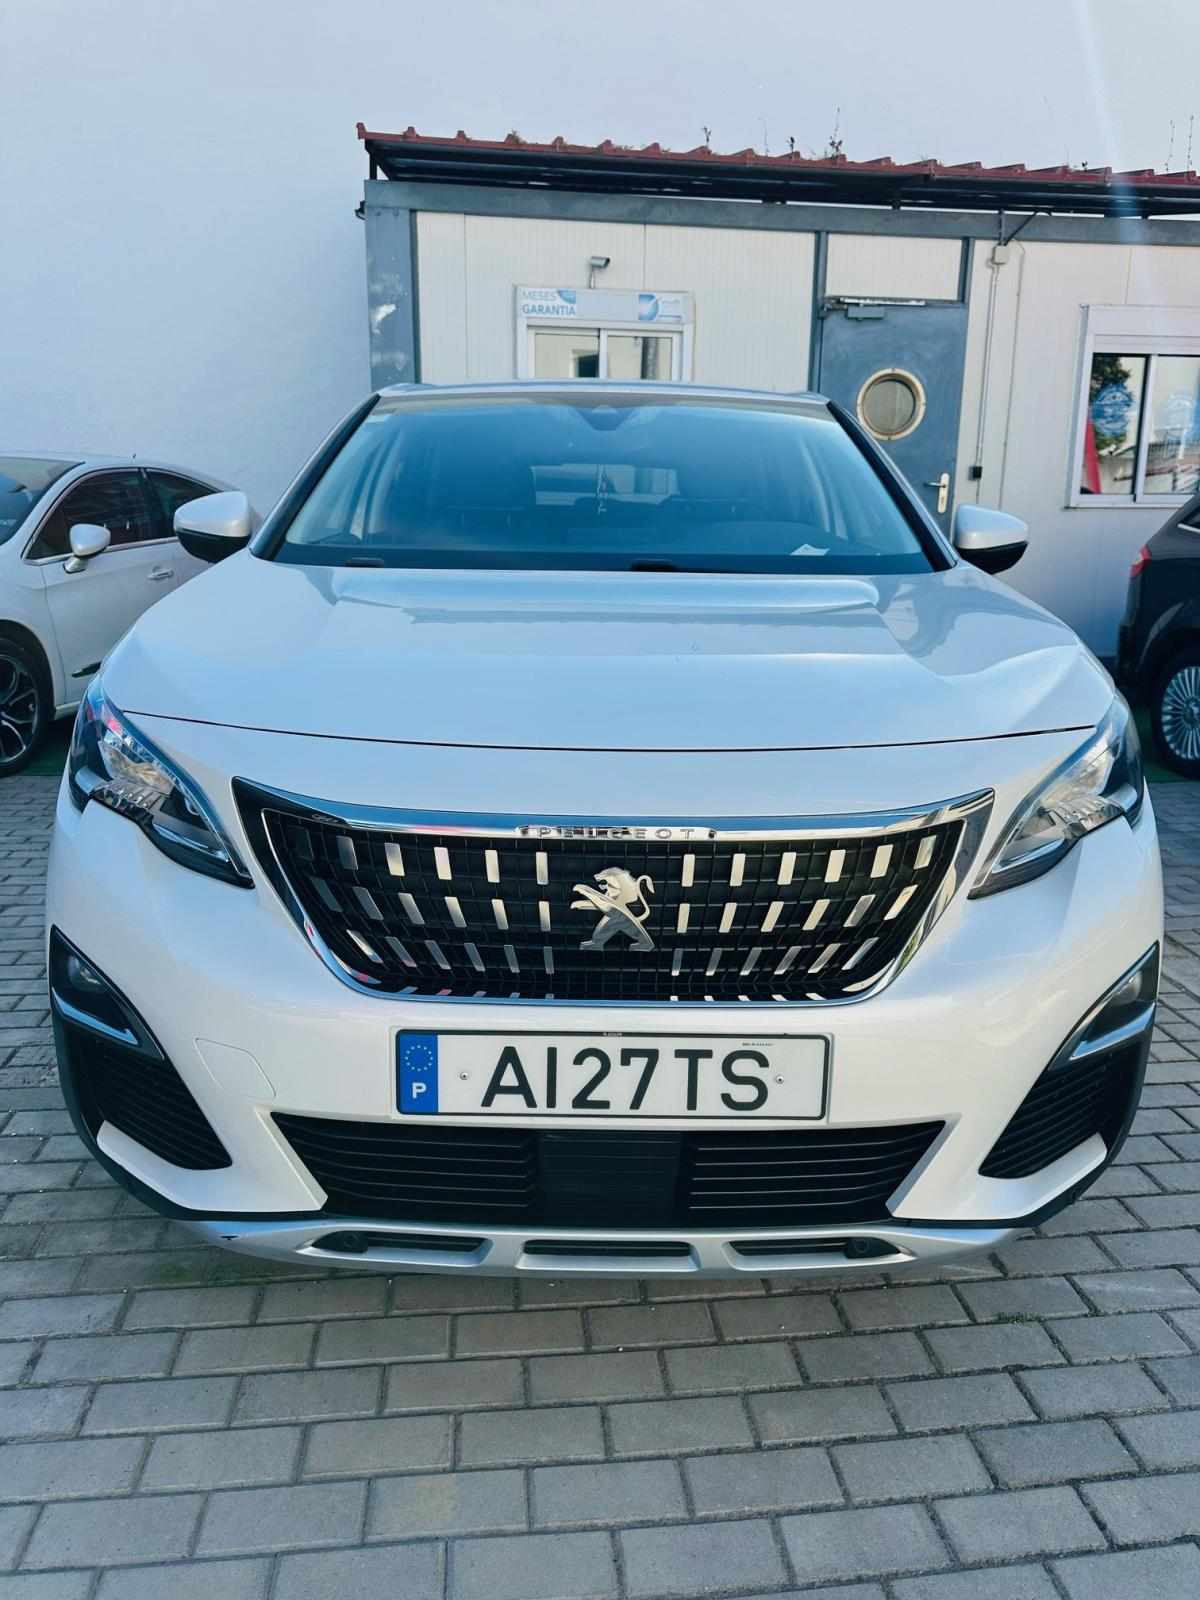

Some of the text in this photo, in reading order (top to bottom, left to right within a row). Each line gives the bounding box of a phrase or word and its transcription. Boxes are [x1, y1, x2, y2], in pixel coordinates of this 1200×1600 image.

[522, 303, 576, 316] GARANTIA
[538, 826, 695, 840] PEUGEOT
[411, 1082, 427, 1099] P
